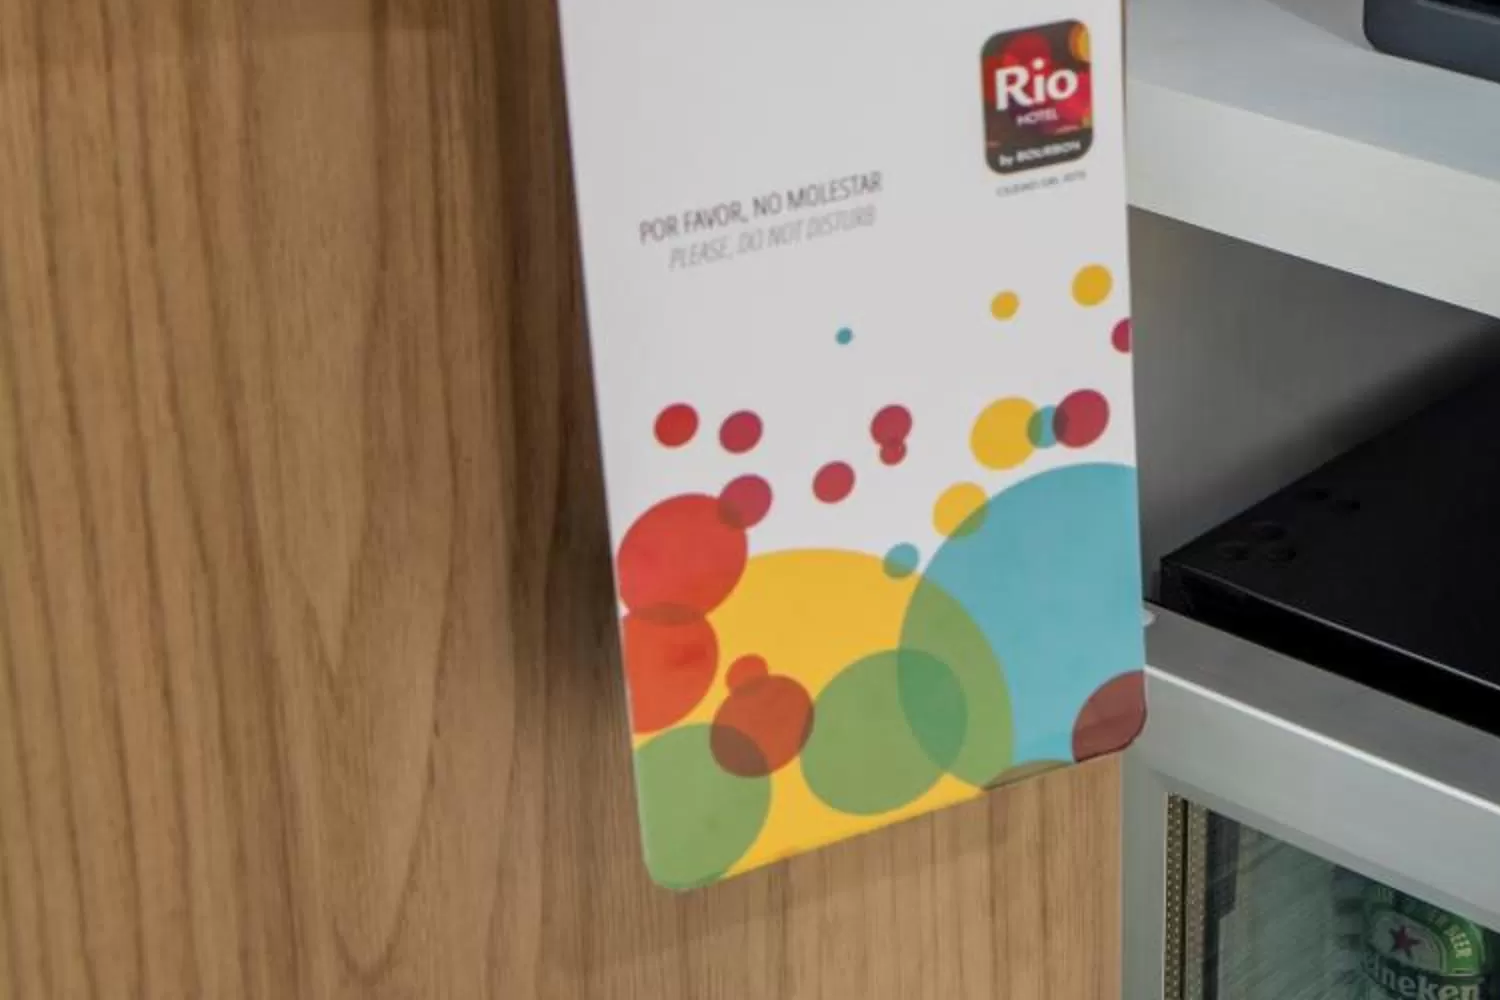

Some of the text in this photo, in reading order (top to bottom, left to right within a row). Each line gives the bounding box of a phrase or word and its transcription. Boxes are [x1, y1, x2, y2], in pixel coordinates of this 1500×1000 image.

[994, 56, 1079, 112] Rio
[1016, 107, 1059, 127] HOTEL
[639, 169, 884, 245] POR FAVOR, NO MOLESTAR
[736, 227, 765, 255] DO
[766, 217, 806, 249] NOT
[805, 202, 878, 241] DISTURB
